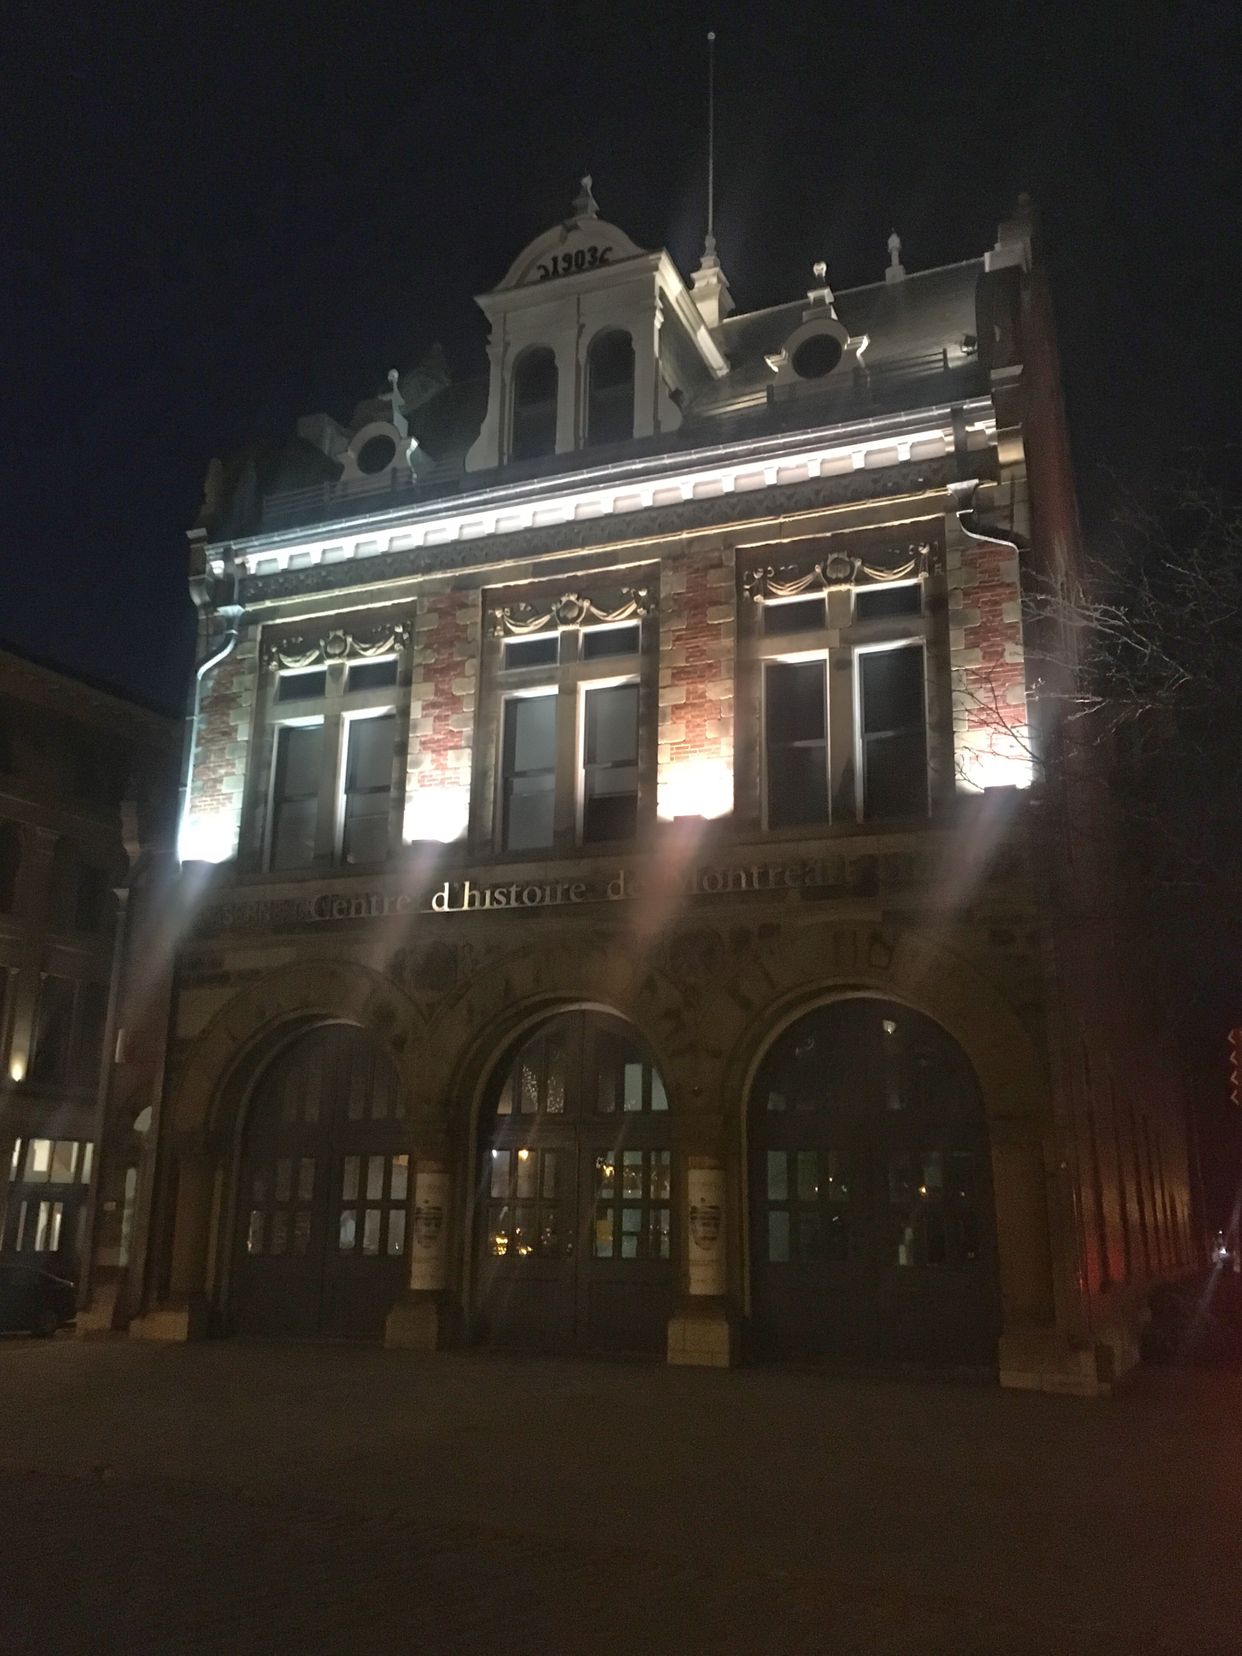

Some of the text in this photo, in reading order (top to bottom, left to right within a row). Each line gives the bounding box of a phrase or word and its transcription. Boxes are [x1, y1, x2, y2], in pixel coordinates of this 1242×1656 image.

[551, 245, 598, 277] 1903
[310, 894, 411, 920] Centre
[431, 879, 586, 912] d'histoire
